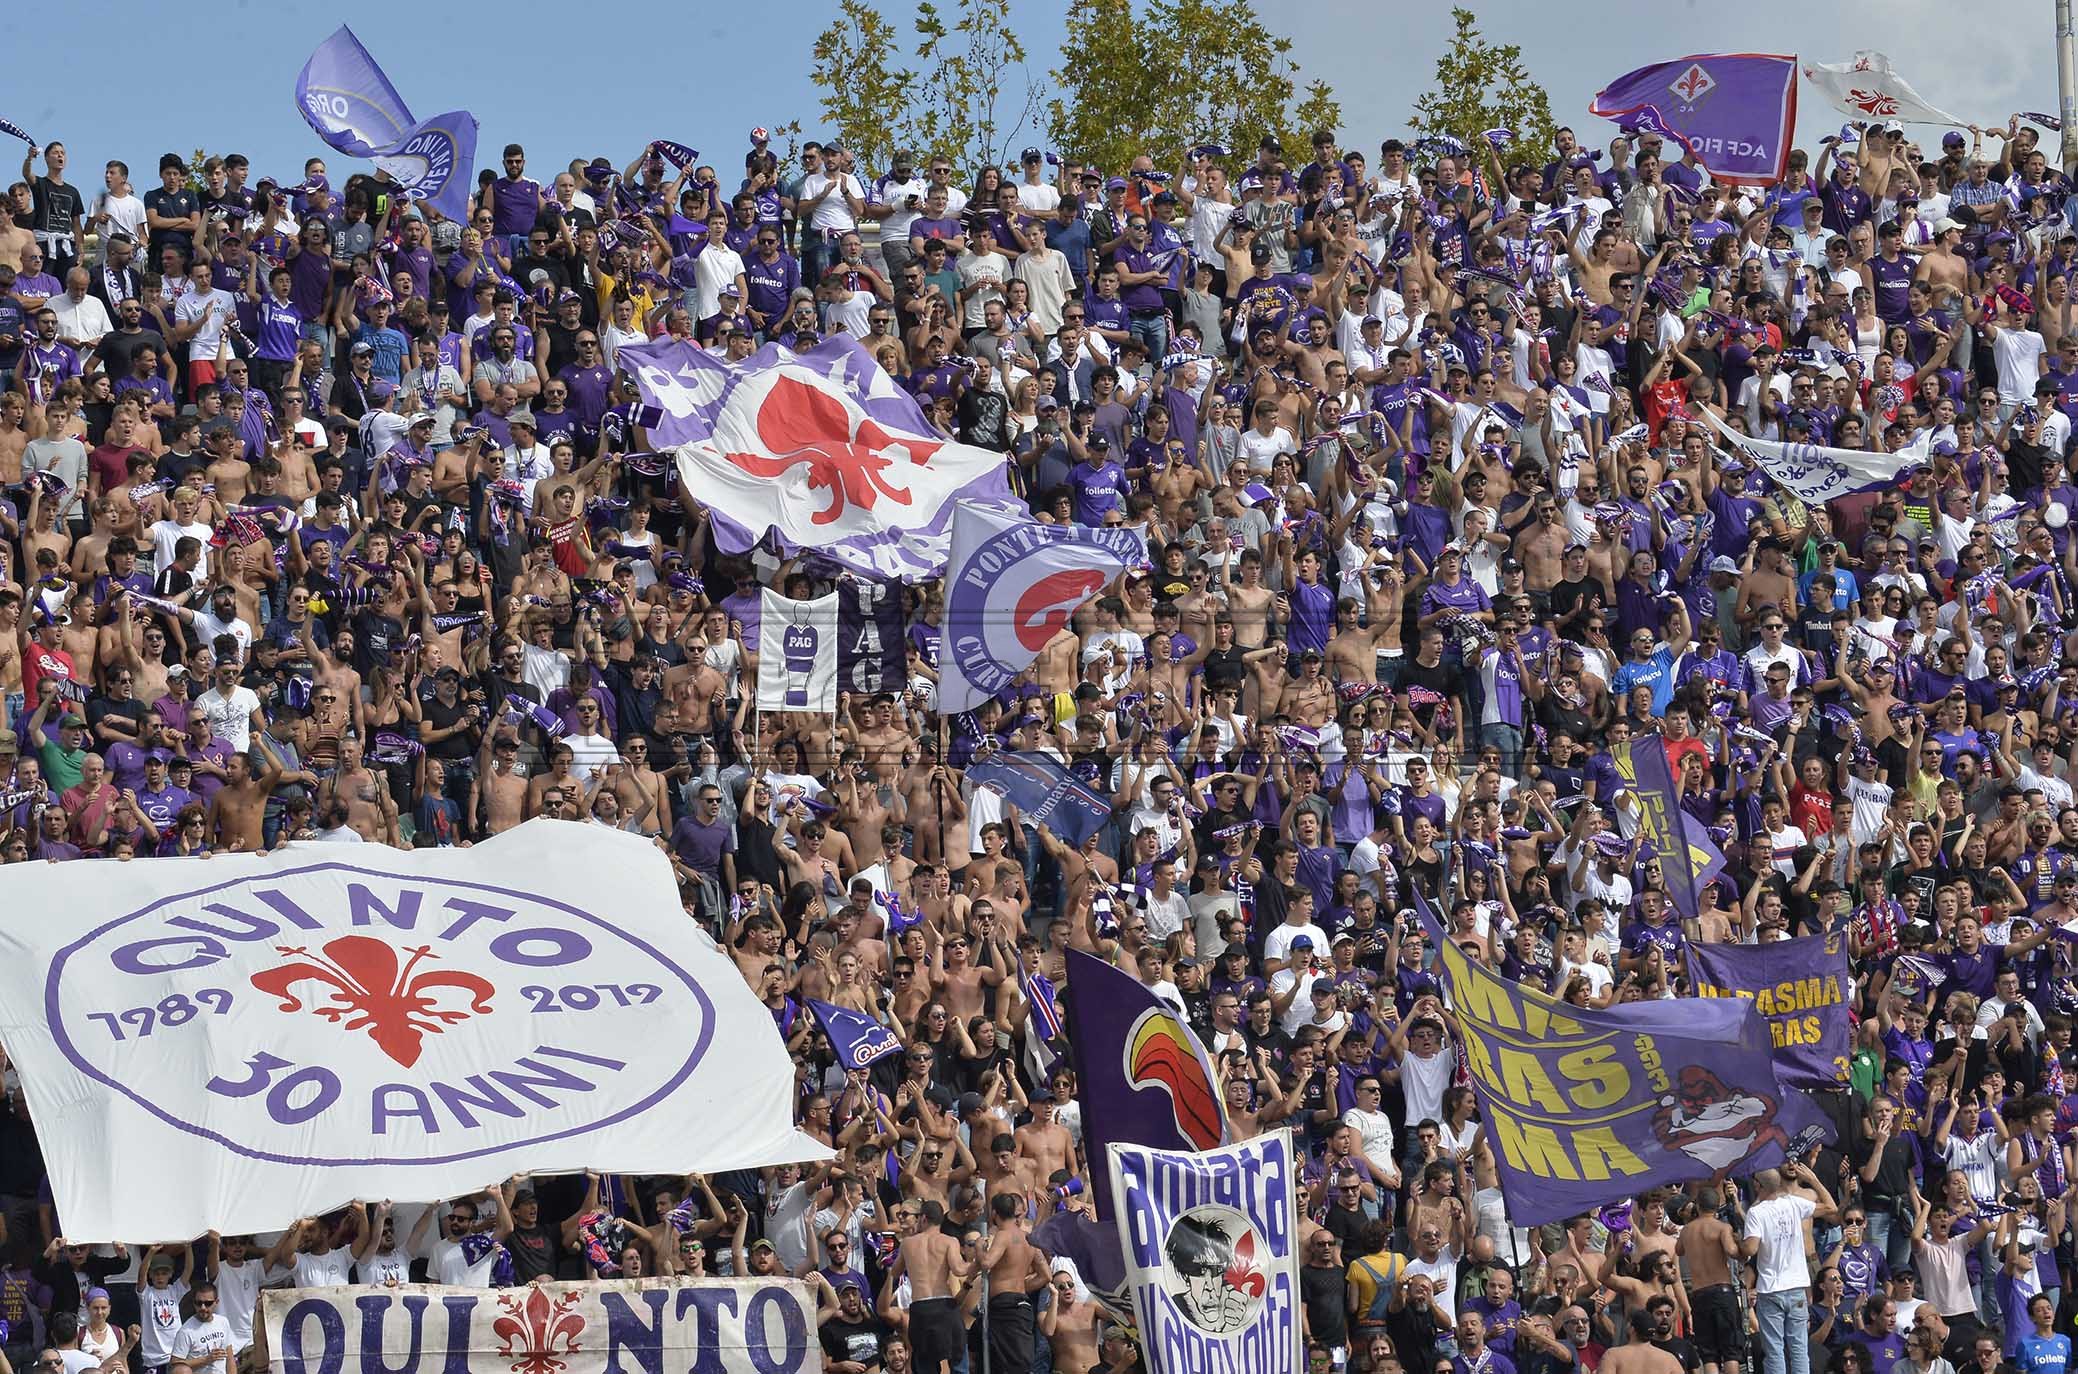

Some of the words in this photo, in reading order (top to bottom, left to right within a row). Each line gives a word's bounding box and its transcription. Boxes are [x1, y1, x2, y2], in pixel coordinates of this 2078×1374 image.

[751, 276, 782, 288] folletto
[193, 306, 225, 319] fotto
[1096, 319, 1119, 329] ediacom
[964, 525, 1054, 590] PONTE
[1064, 527, 1081, 542] A
[788, 636, 813, 649] PAG
[851, 583, 887, 694] PAG
[1805, 620, 1832, 631] Timberl
[1632, 670, 1663, 686] folletto
[111, 882, 593, 976] QUINTO
[87, 987, 235, 1041] 1989
[520, 983, 663, 1014] 2019
[1454, 1008, 1631, 1114] RAS
[206, 1052, 341, 1126] 30
[371, 1045, 627, 1135] ANNI
[1488, 1102, 1651, 1181] MA
[1119, 1138, 1289, 1268] amiata
[200, 1331, 225, 1344] QUINTO
[281, 1294, 478, 1374] QUI
[600, 1286, 808, 1374] NTO
